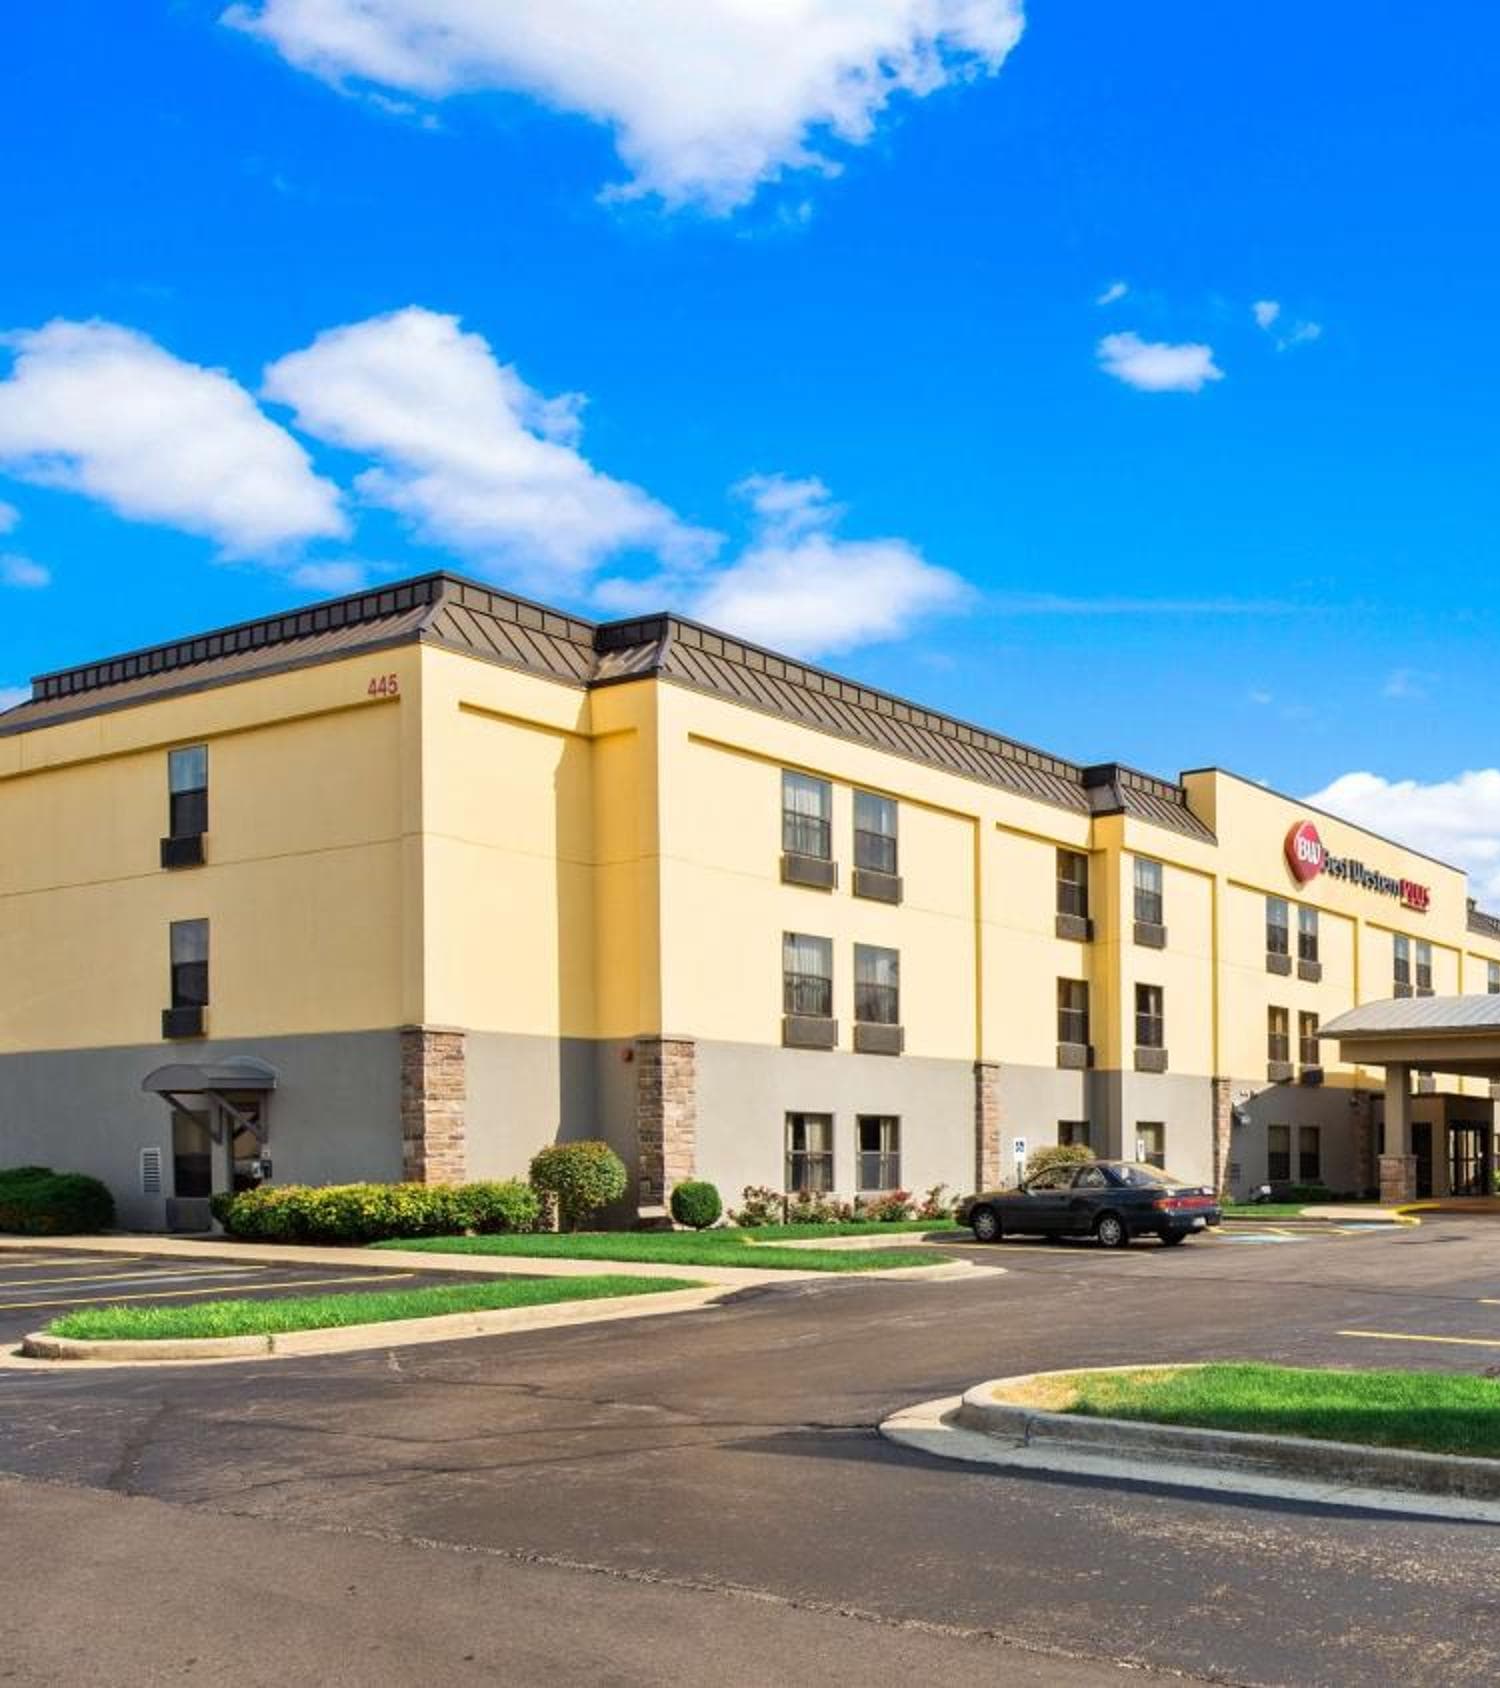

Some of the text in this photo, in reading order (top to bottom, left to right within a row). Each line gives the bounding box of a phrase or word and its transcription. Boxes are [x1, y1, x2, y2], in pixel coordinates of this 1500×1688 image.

[1298, 836, 1321, 865] BW
[1320, 847, 1430, 907] Best Western PLUS
